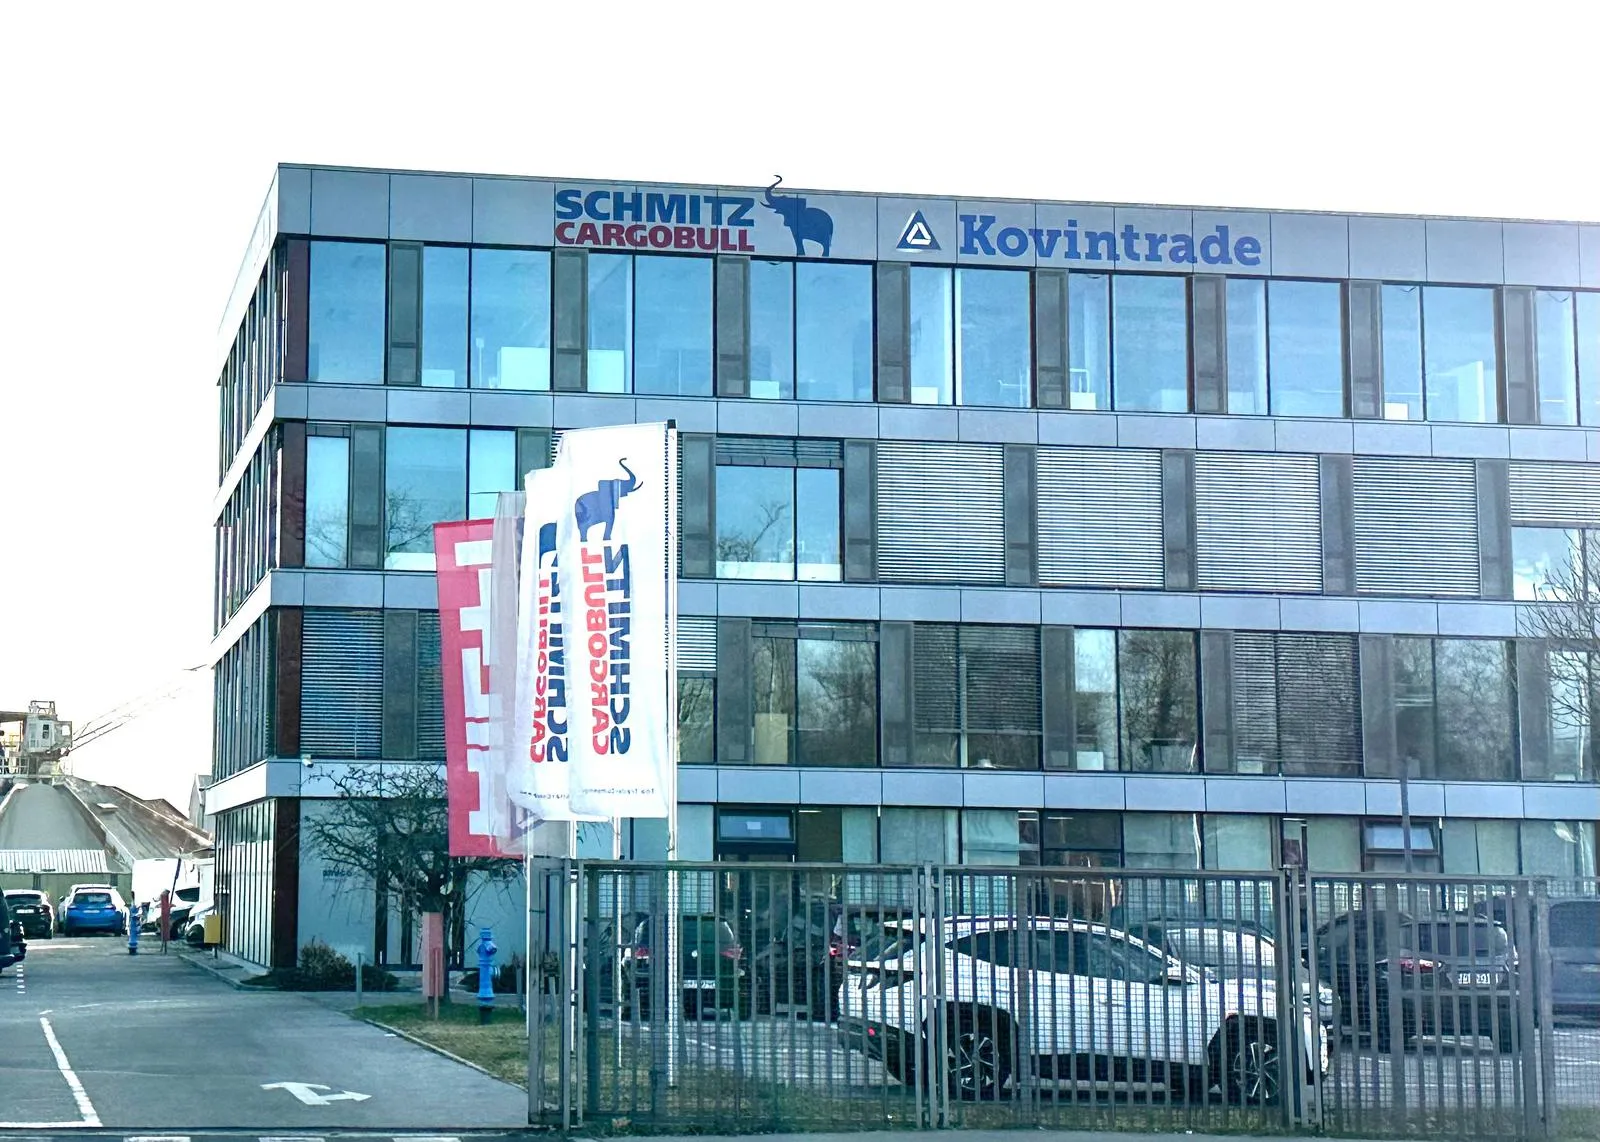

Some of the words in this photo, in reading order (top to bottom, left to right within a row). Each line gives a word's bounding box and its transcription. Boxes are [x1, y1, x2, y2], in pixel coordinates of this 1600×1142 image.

[555, 189, 755, 227] SCHMITZ
[555, 222, 755, 252] CARGOBULL
[959, 214, 1262, 266] Kovintrade
